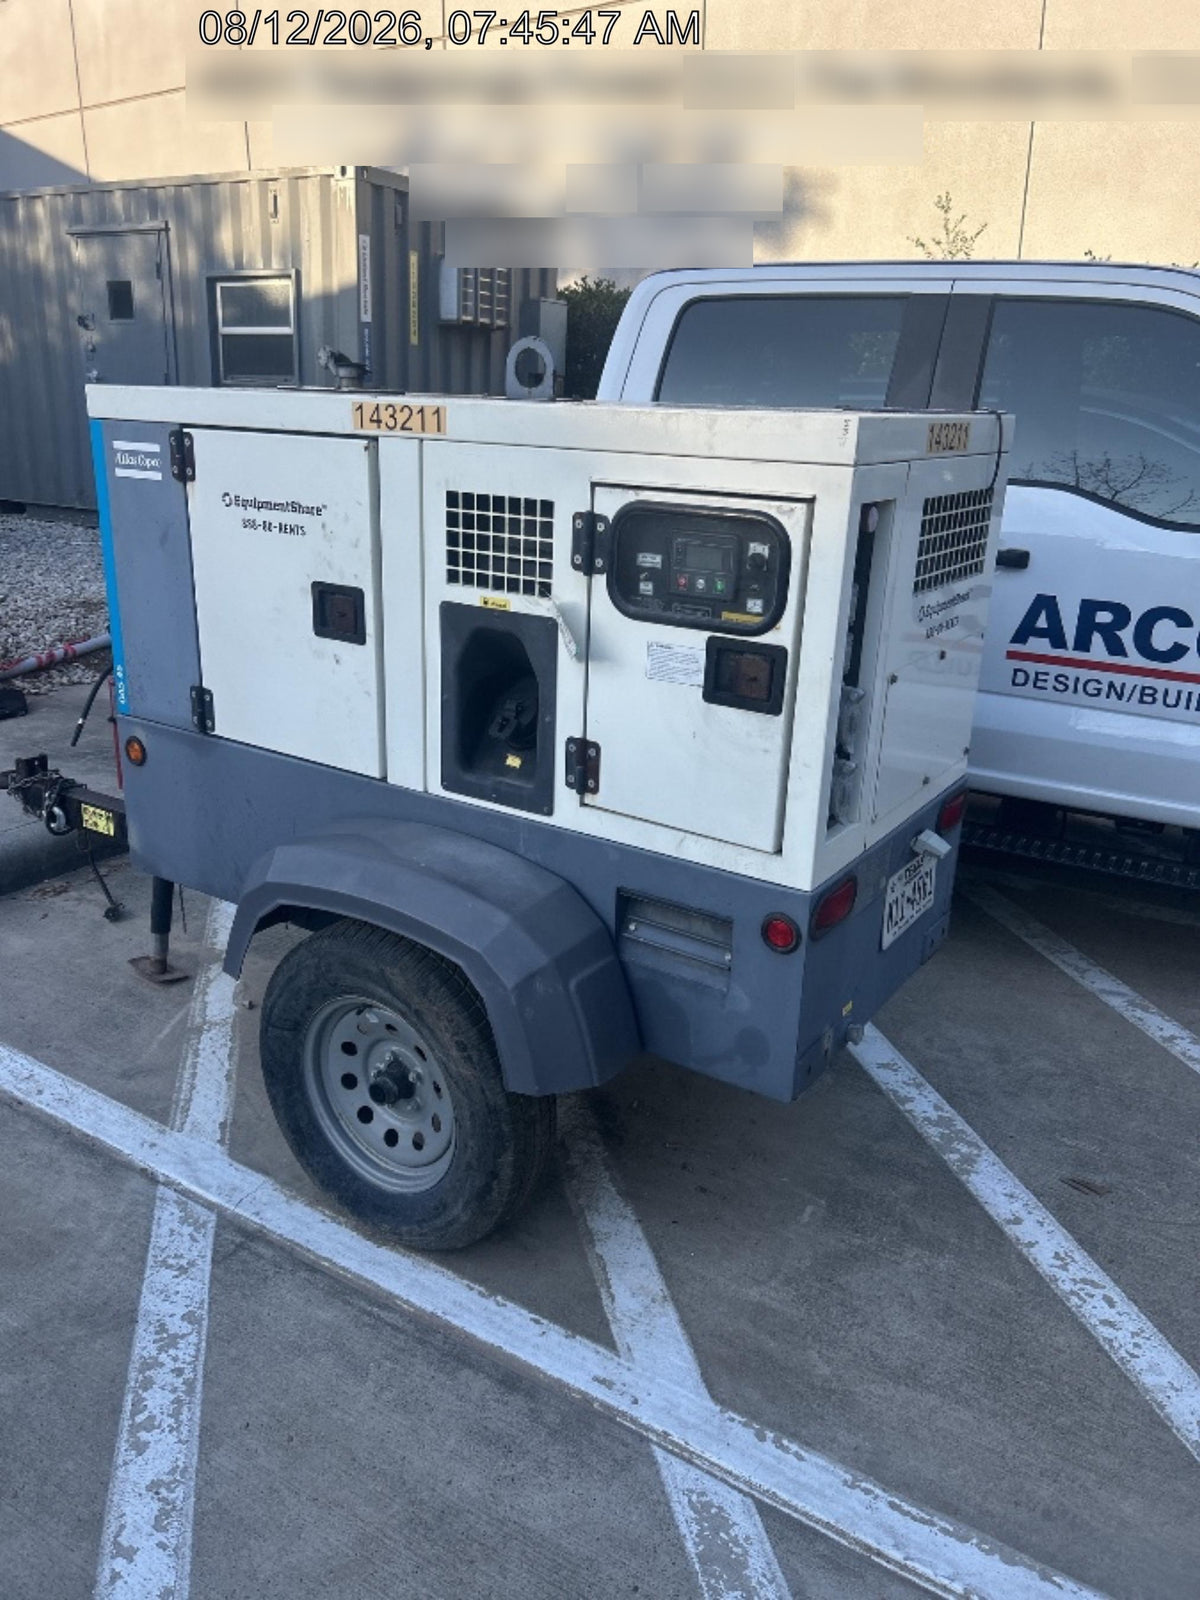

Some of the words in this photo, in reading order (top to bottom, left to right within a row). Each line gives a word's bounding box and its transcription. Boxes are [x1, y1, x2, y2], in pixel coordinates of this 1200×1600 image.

[355, 403, 442, 433] 143211
[930, 422, 969, 451] 143211
[1009, 593, 1200, 664] ARC
